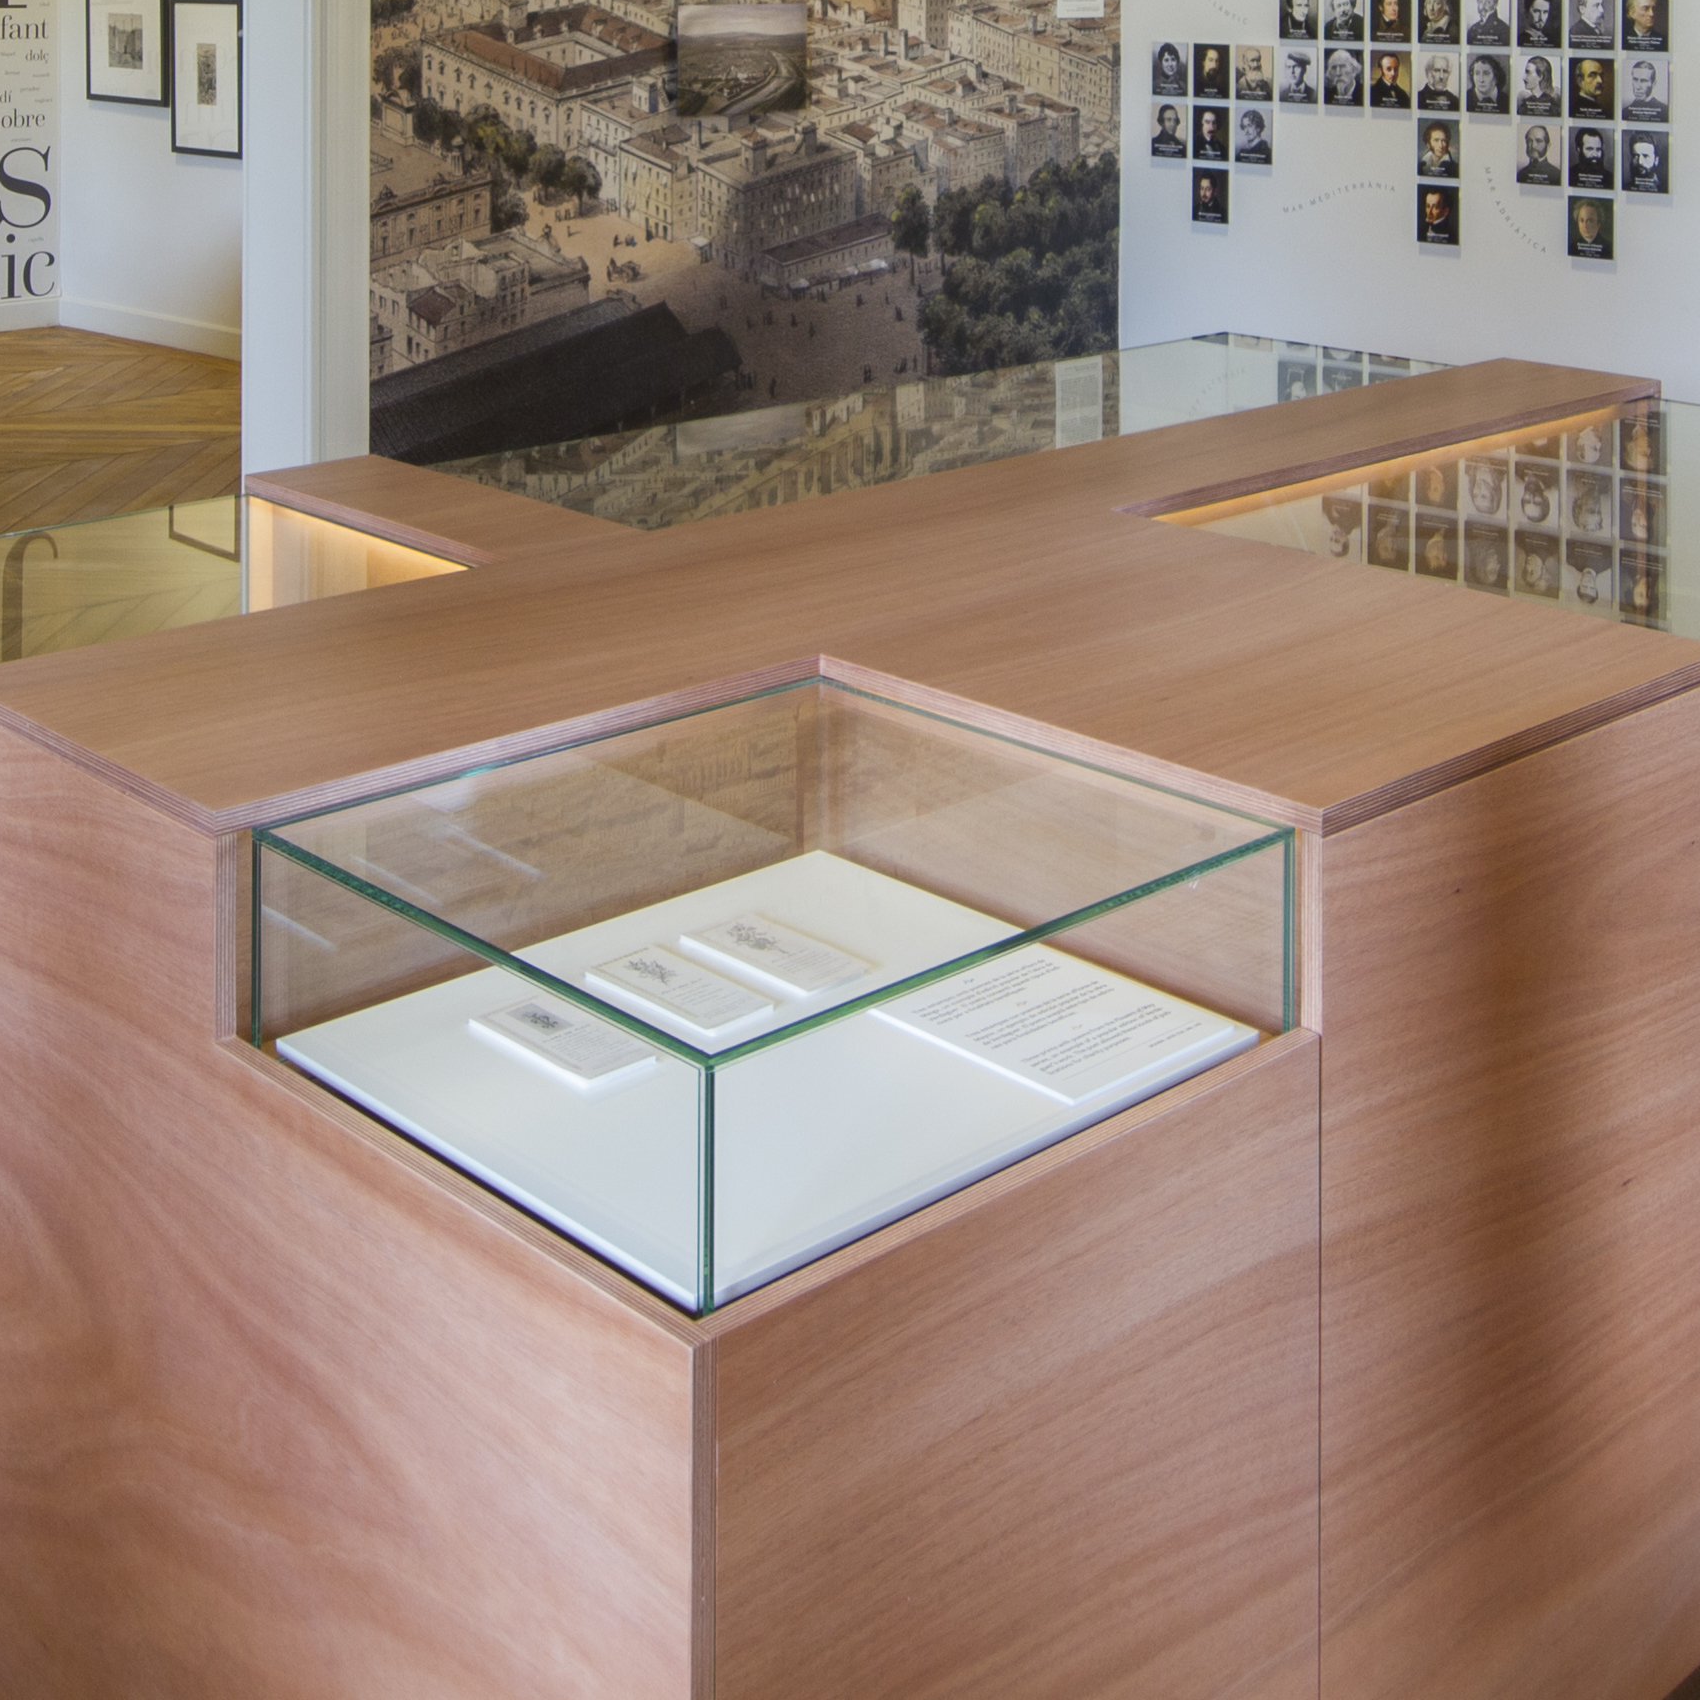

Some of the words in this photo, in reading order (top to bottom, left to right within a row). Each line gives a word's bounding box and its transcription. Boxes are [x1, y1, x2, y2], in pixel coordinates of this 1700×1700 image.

[25, 49, 49, 63] dolç
[1485, 167, 1497, 192] MAR
[1283, 204, 1303, 213] MAR
[1310, 181, 1396, 205] MEDITERRÀNIA
